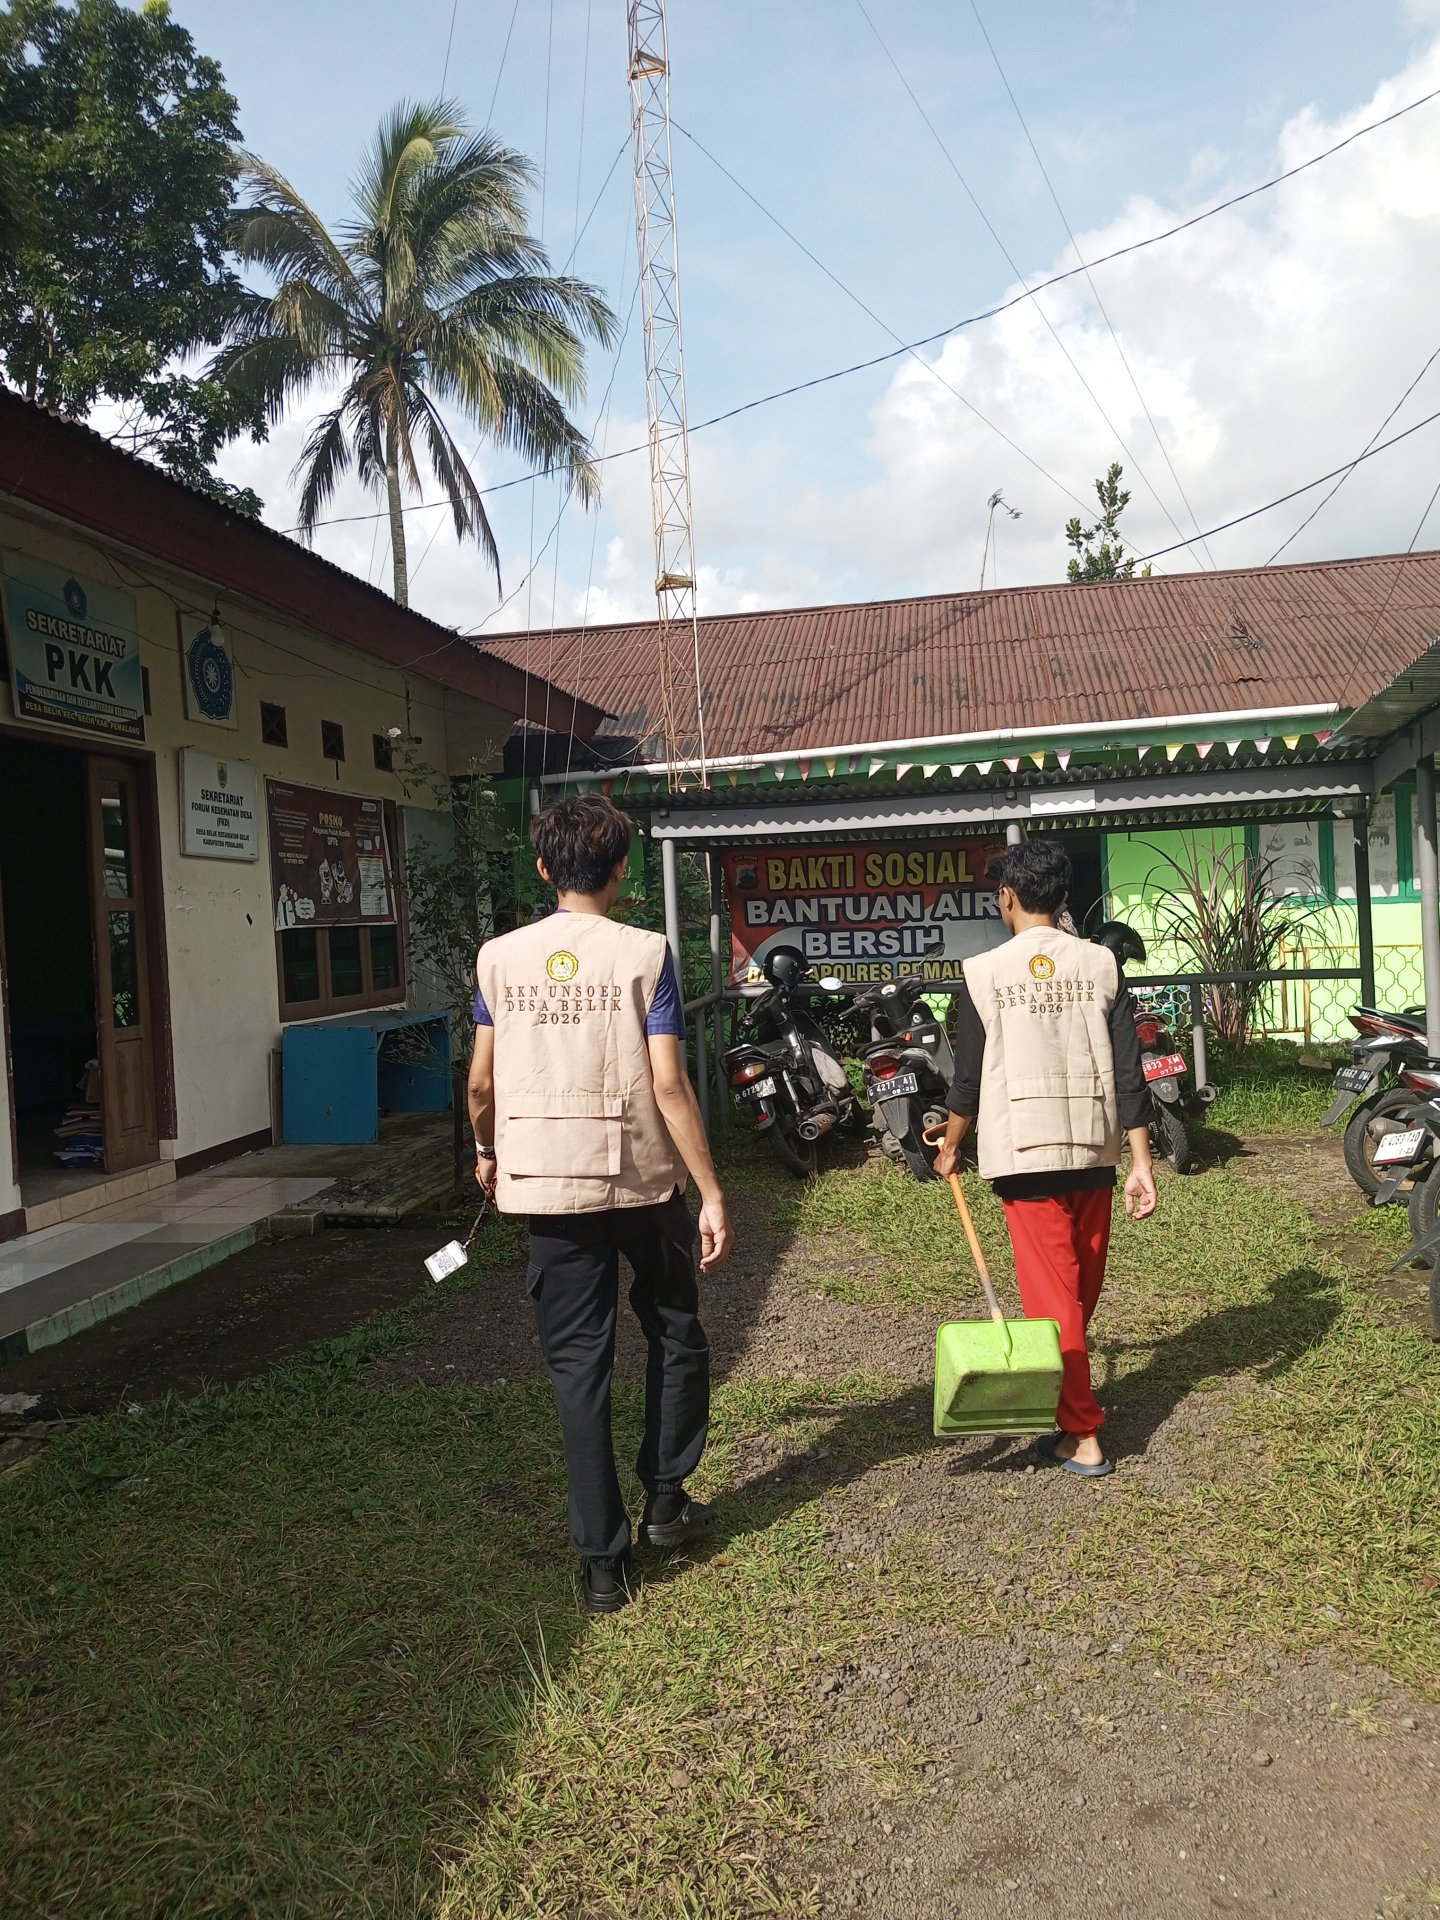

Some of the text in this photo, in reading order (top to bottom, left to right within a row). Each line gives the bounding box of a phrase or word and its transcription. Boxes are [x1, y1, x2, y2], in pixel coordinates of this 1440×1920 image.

[26, 608, 125, 658] SEKRETARIAT
[45, 642, 116, 698] PKK
[25, 701, 43, 713] DESA
[43, 704, 62, 716] BELIK
[110, 720, 140, 735] PEMALANG
[200, 788, 244, 807] SEKRETARIAT
[191, 802, 253, 820] FORUM KESEHATAN DESA
[216, 817, 230, 829] (FKD)
[319, 812, 343, 828] POSKO
[767, 850, 974, 891] BAKTI SOSIAL
[746, 891, 1001, 925] BANTUAN AIR
[804, 928, 942, 957] BERSIH
[803, 962, 893, 982] APOLRES
[505, 985, 622, 998] KKN UNSOED
[995, 981, 1095, 998] KKN UNSOED
[507, 999, 622, 1012] DESA BELIK
[997, 992, 1095, 1009] DESA BELIK
[1030, 1004, 1063, 1014] 2026
[540, 1013, 581, 1025] 2026
[742, 1084, 760, 1098] 6729
[868, 1089, 874, 1097] G
[876, 1080, 896, 1092] 4277
